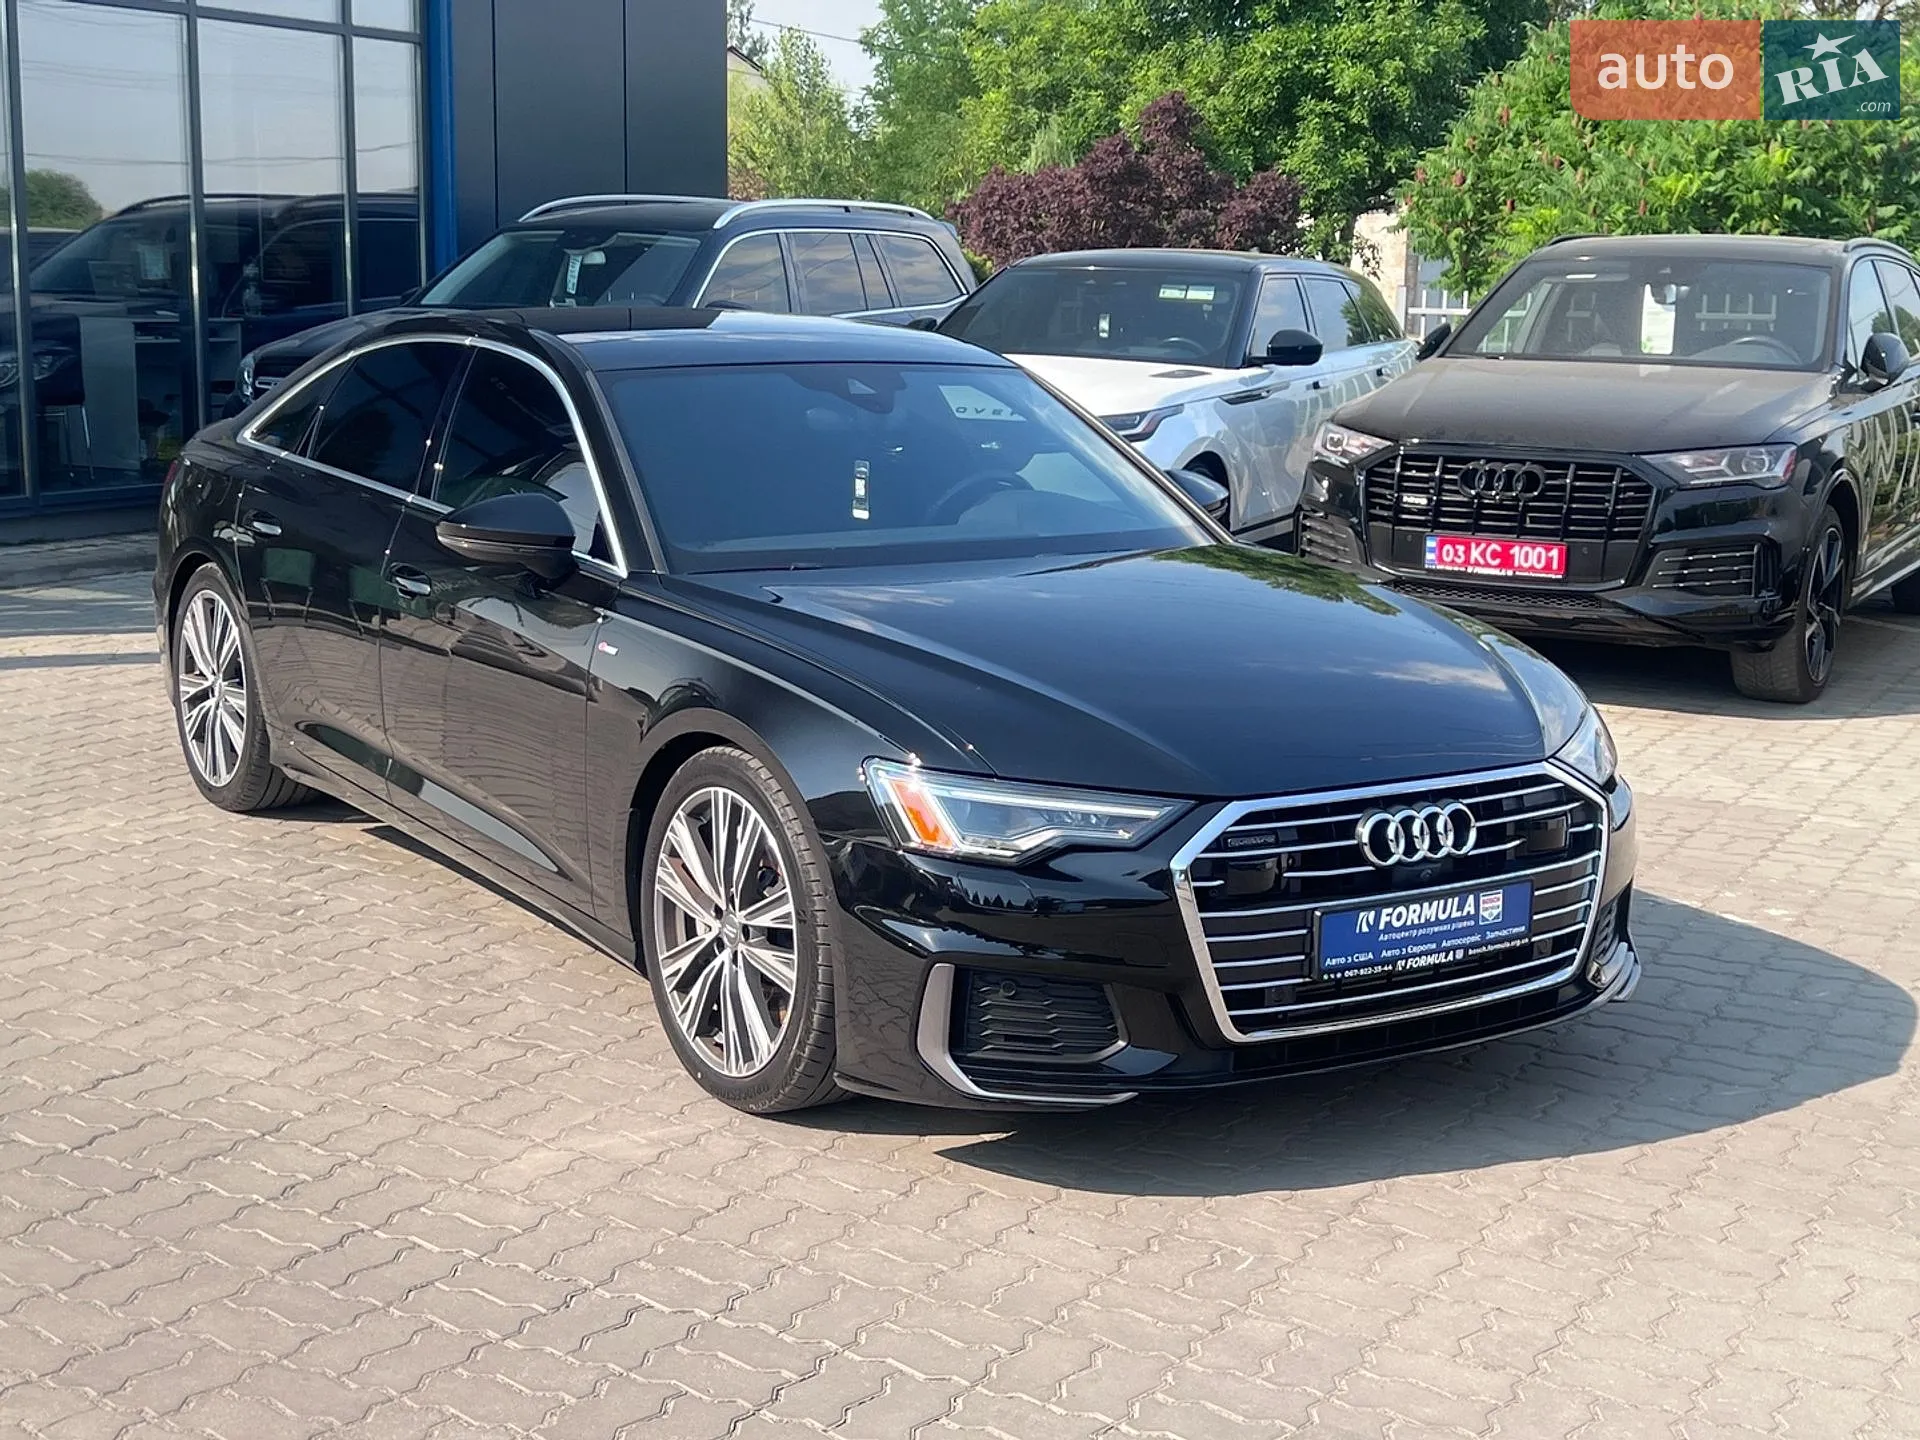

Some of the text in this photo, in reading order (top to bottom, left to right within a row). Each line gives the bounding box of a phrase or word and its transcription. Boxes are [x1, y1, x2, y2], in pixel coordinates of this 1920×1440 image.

[1441, 544, 1466, 563] 03
[1469, 542, 1502, 566] KC
[1509, 545, 1559, 571] 1001
[1378, 894, 1475, 930] FORMULA
[1325, 957, 1346, 966] Авто
[1353, 952, 1374, 962] США
[1381, 949, 1400, 958] Авто
[1406, 950, 1454, 970] FORMULA
